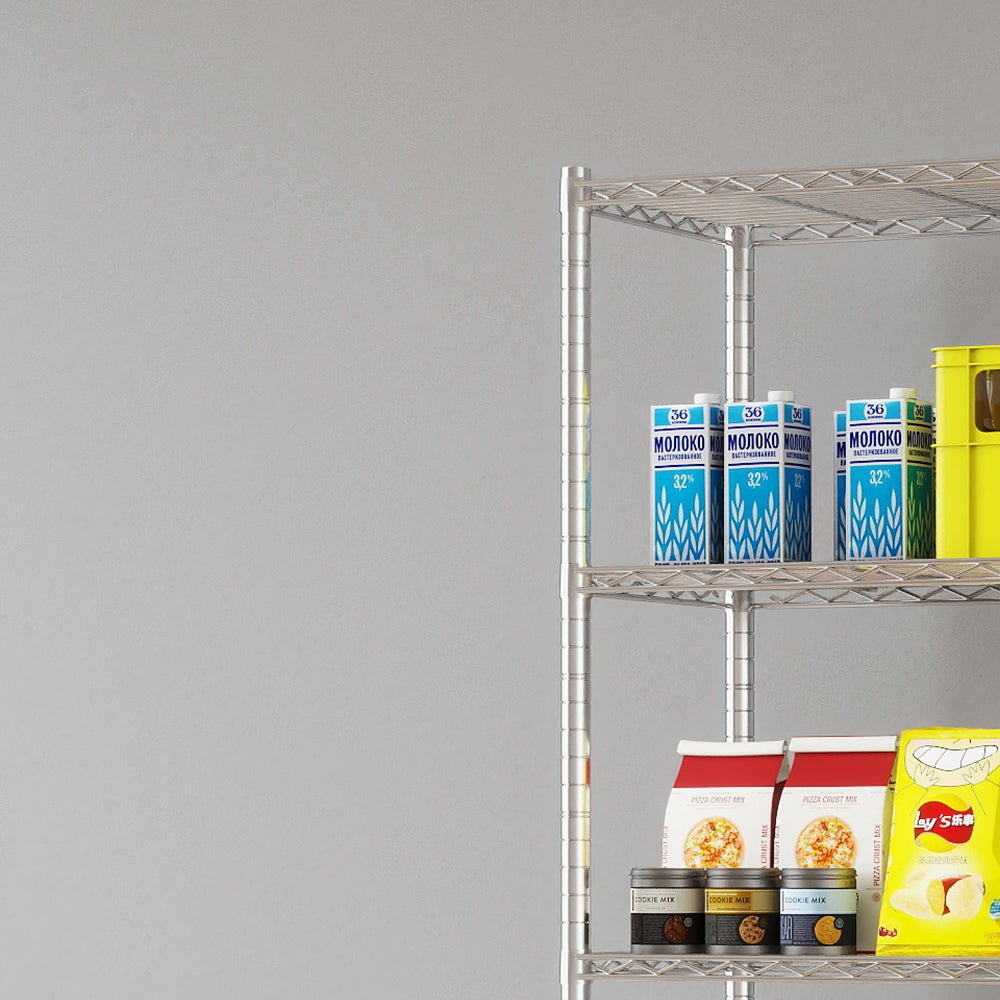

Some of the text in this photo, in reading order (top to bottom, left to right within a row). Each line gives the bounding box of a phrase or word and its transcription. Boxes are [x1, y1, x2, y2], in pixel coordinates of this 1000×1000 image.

[671, 409, 688, 420] 36
[745, 406, 762, 418] 36
[867, 404, 884, 415] 36
[654, 434, 705, 453] МОЛОКО
[728, 432, 779, 451] МОЛОКО
[849, 429, 902, 448] МОЛОКО
[691, 796, 746, 804] PIZZA CRUST MIX
[803, 795, 858, 804] PIZZA CRUST MIX
[873, 866, 881, 887] PIZZA
